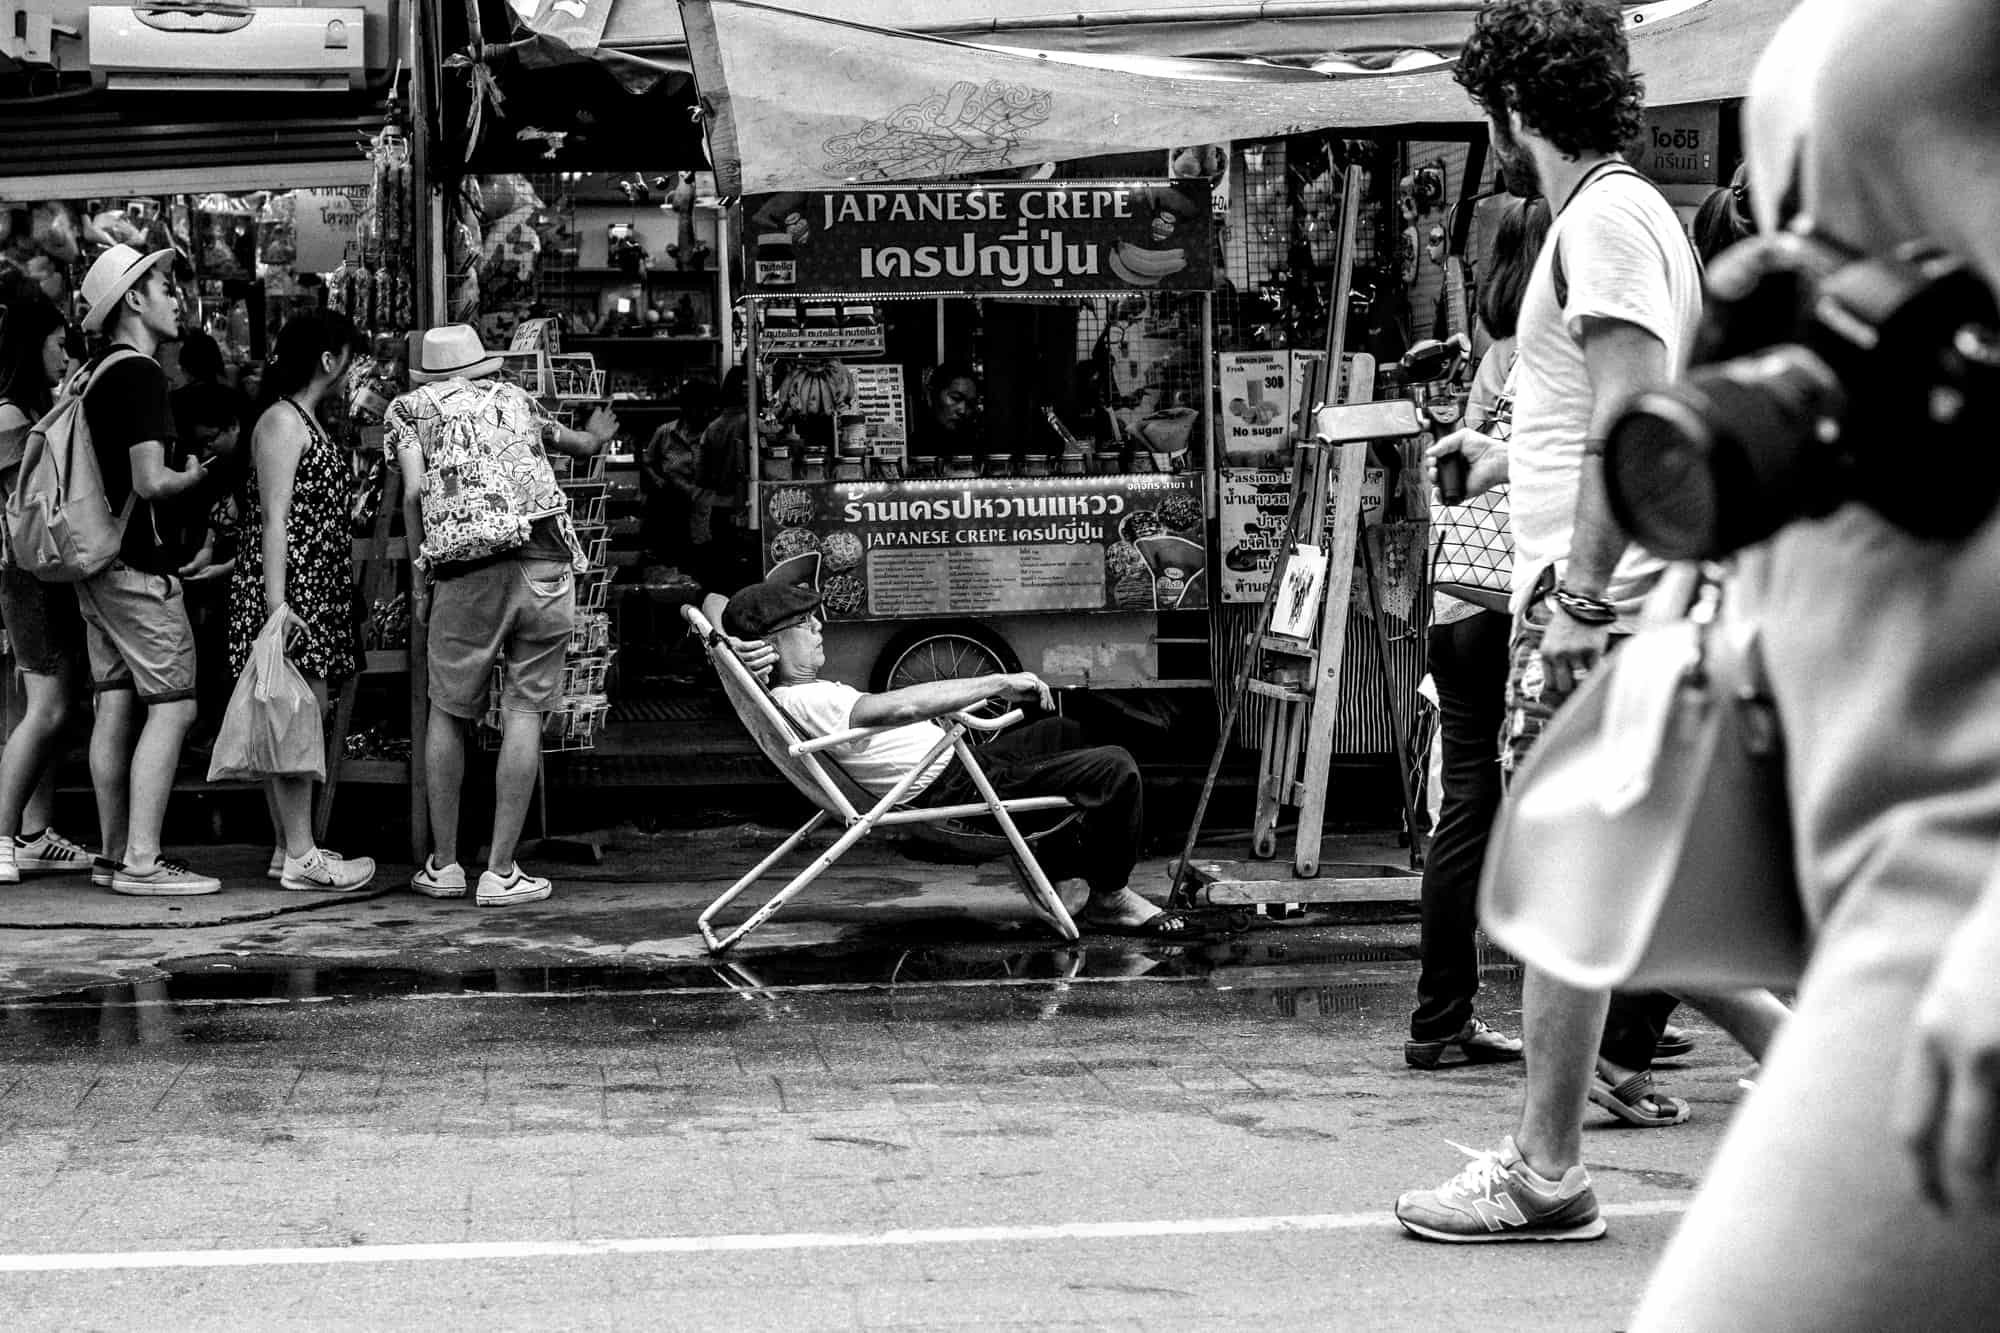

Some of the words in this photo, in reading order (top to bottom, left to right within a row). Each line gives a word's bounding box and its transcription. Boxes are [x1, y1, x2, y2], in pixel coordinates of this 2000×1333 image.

[823, 191, 1007, 231] JAPANESE
[1019, 189, 1133, 221] CREPE
[860, 217, 1099, 288] เครปญี่ปุ่น
[1233, 426, 1249, 438] No
[1251, 426, 1284, 438] sugar
[844, 487, 1125, 522] ร้านเครปหวานแหวว
[866, 529, 951, 550] JAPANESE
[955, 528, 1007, 543] CREPE
[1012, 516, 1104, 545] เครปญี่ปุ่น
